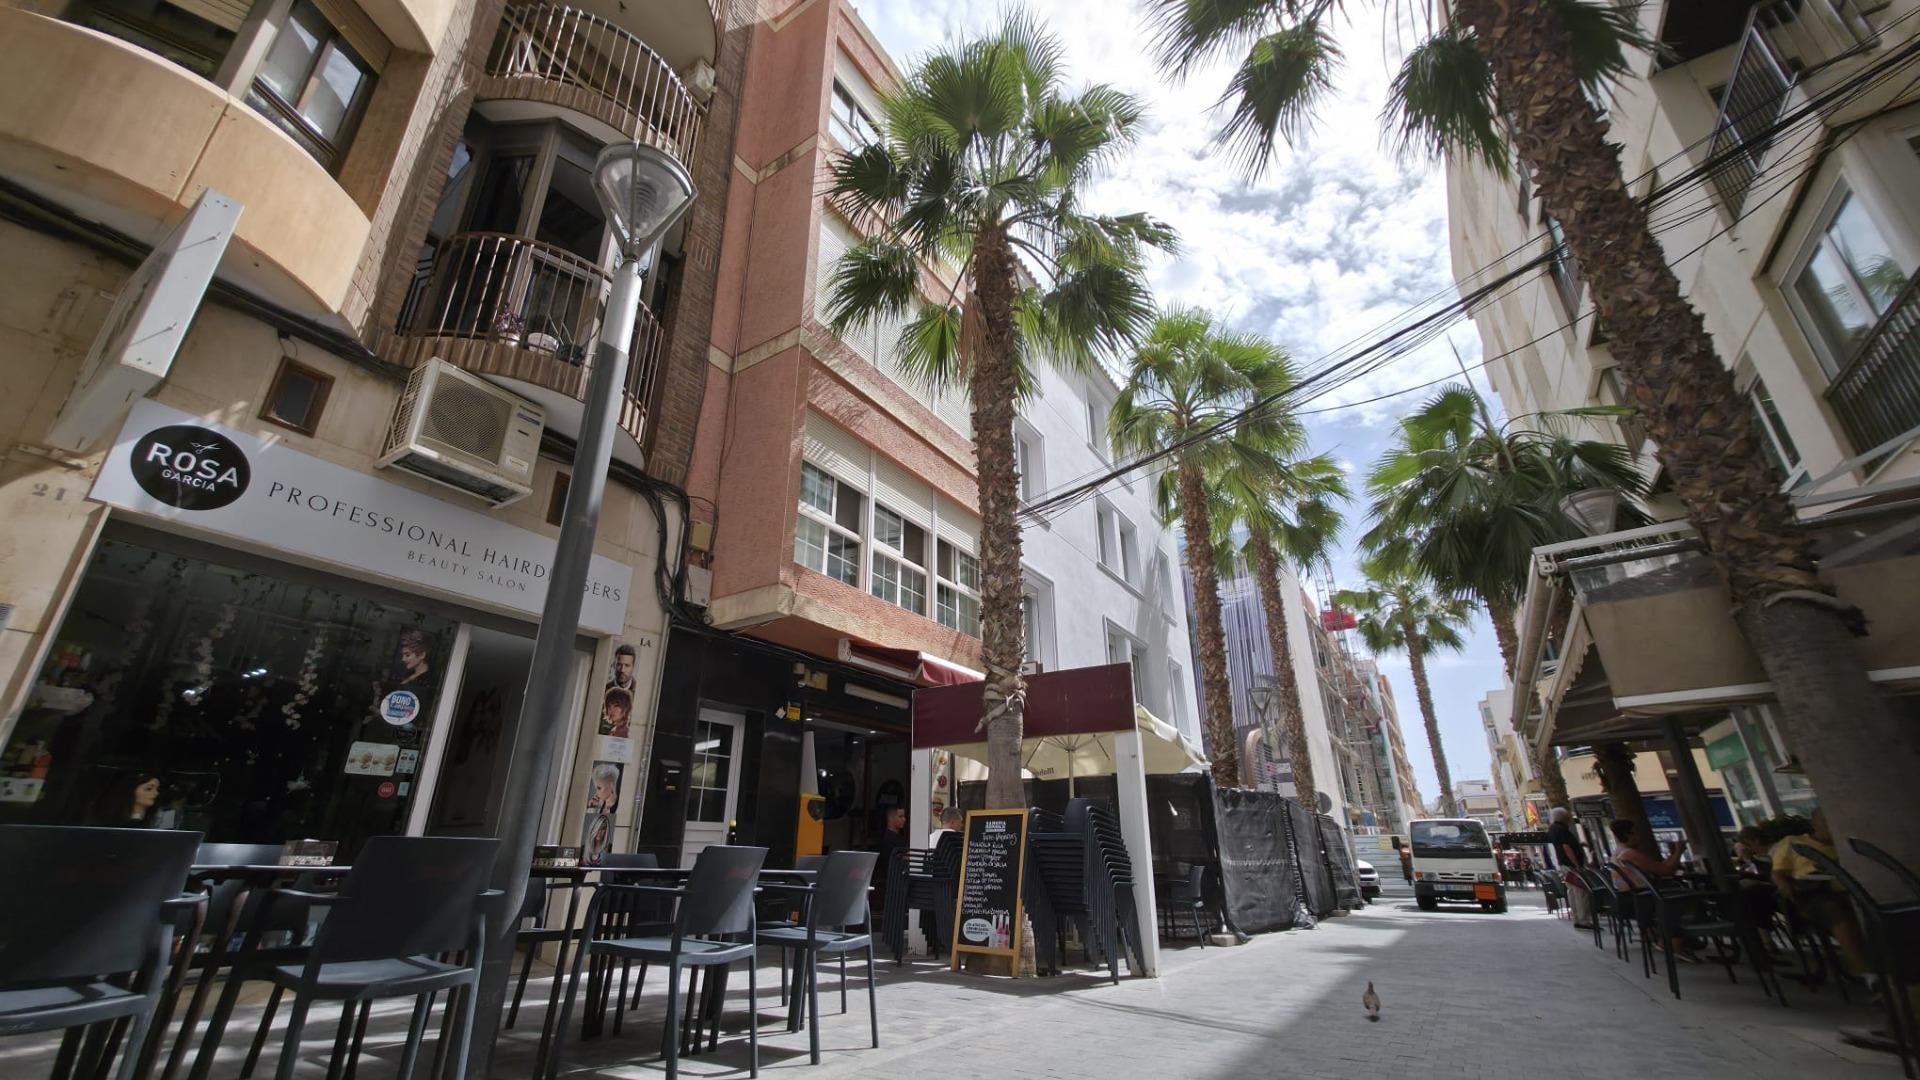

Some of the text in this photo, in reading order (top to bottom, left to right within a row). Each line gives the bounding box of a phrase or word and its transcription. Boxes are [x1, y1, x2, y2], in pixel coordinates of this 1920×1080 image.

[147, 442, 238, 488] ROSA
[161, 468, 216, 492] GARCIA
[269, 481, 621, 602] PROFESSIONAL HAIRDSERS
[407, 550, 527, 593] BEAUTY SALON
